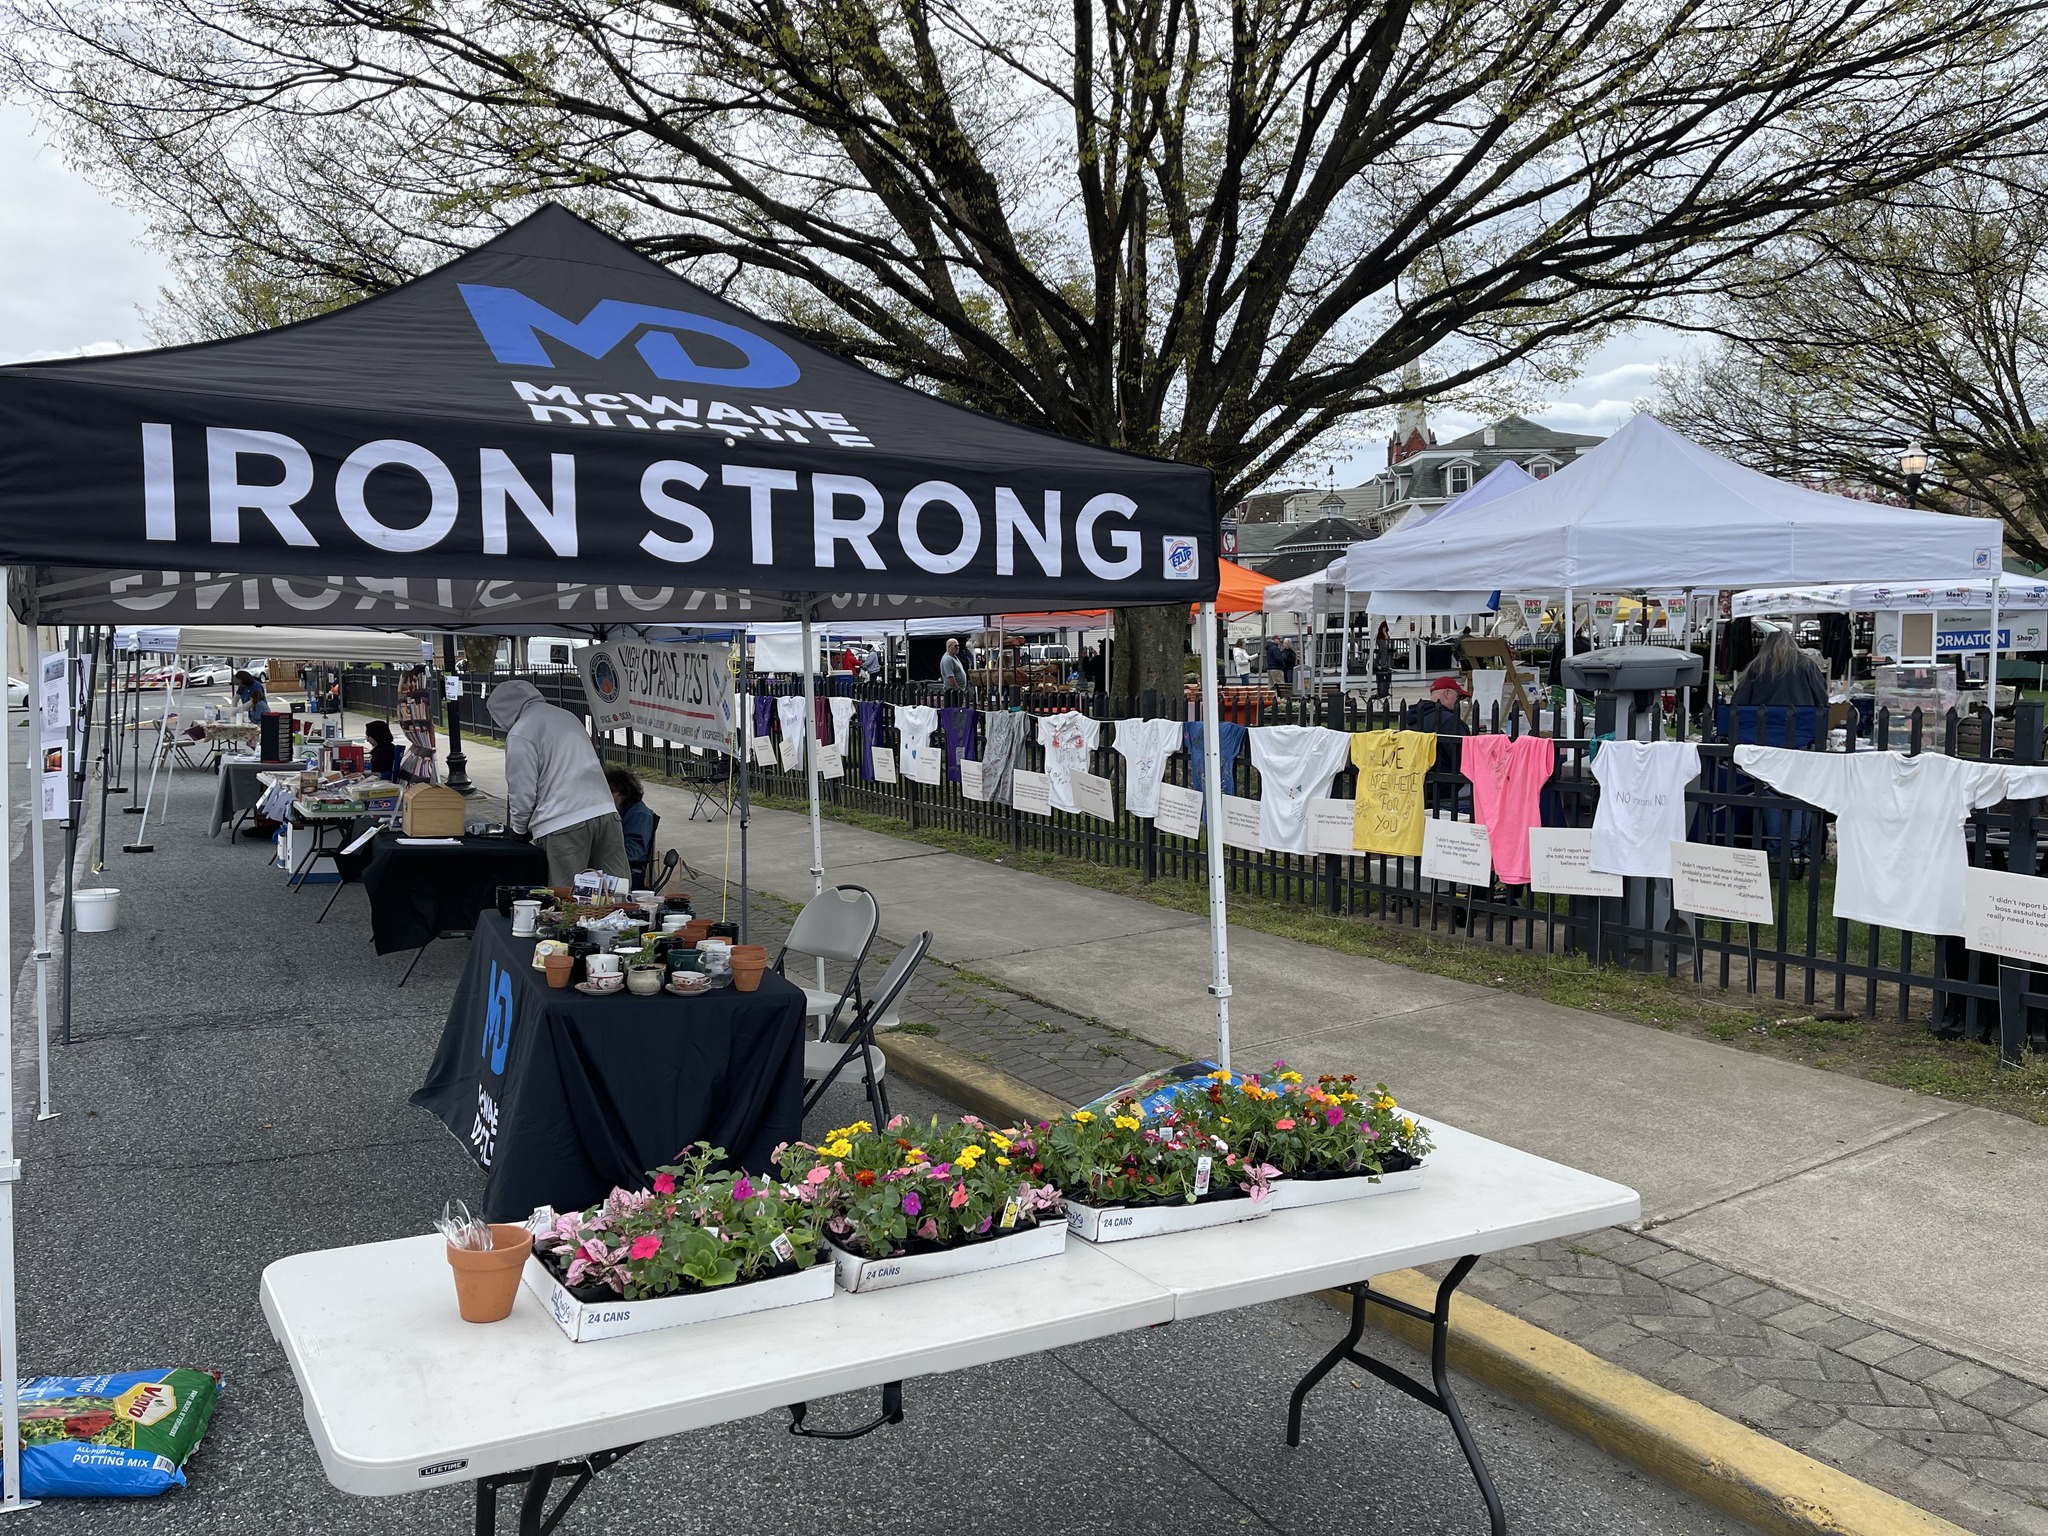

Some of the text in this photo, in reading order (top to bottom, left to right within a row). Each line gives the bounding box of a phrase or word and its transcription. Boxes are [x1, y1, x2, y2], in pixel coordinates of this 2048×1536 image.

[511, 381, 860, 432] McWANE
[142, 422, 1142, 580] IRON STRONG
[2017, 634, 2033, 642] Shop
[640, 648, 680, 701] SPACE
[682, 652, 711, 706] FEST
[1381, 747, 1404, 769] WE
[1379, 793, 1399, 811] FOR
[1616, 791, 1631, 804] NO
[1655, 794, 1667, 806] NO
[1374, 814, 1398, 833] YOU
[1681, 869, 1702, 878] probably
[1733, 876, 1757, 884] shouldn't
[1711, 866, 1732, 874] because
[1732, 868, 1745, 877] they
[1996, 896, 2017, 906] didn't
[2018, 901, 2041, 910] report
[1986, 912, 2006, 922] really
[2006, 915, 2025, 924] need
[1995, 904, 2046, 919] boss assaulted
[2032, 951, 2048, 959] HELP
[1103, 1217, 1133, 1228] 24 CANS
[865, 1267, 901, 1280] 24 CANS
[587, 1311, 630, 1324] 24 CANS
[76, 1446, 125, 1456] ALL-PURPOSE
[72, 1454, 150, 1468] POTTING MIX
[425, 1462, 462, 1475] LIFETIME
